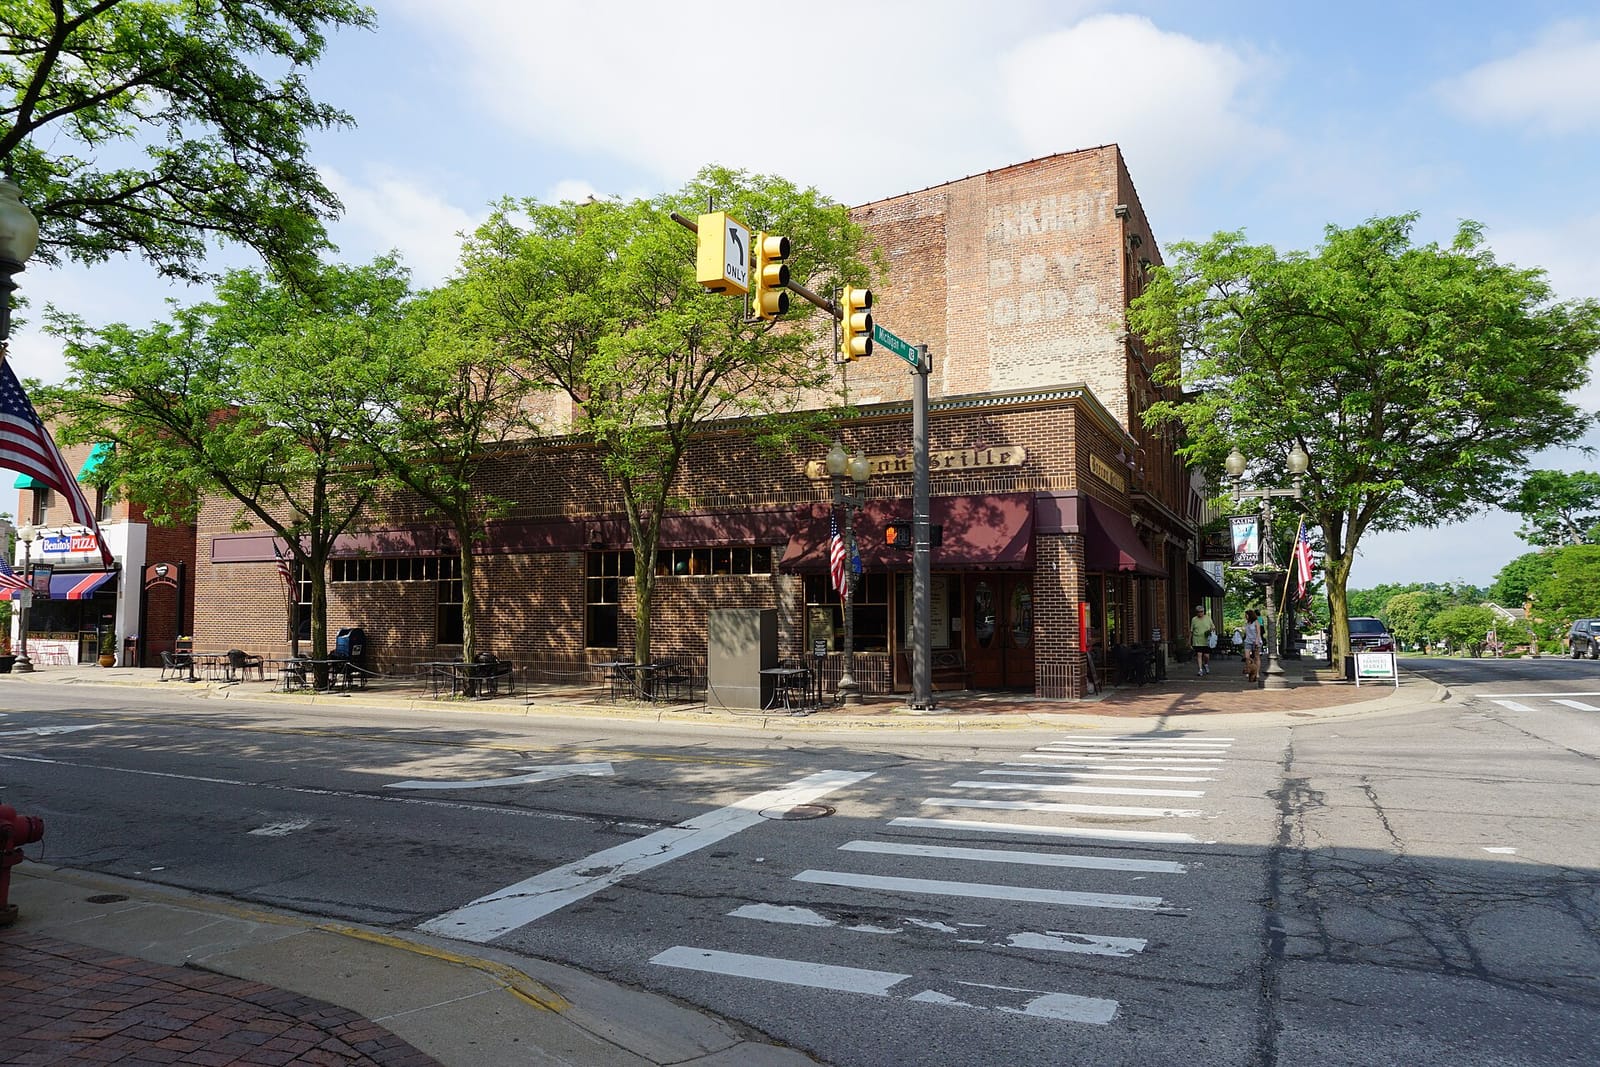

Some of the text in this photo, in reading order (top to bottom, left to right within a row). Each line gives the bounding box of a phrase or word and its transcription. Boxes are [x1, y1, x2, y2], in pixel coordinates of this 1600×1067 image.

[726, 263, 746, 283] ONLY
[879, 327, 899, 350] Michigan
[43, 537, 96, 551] Benito's PIZZA
